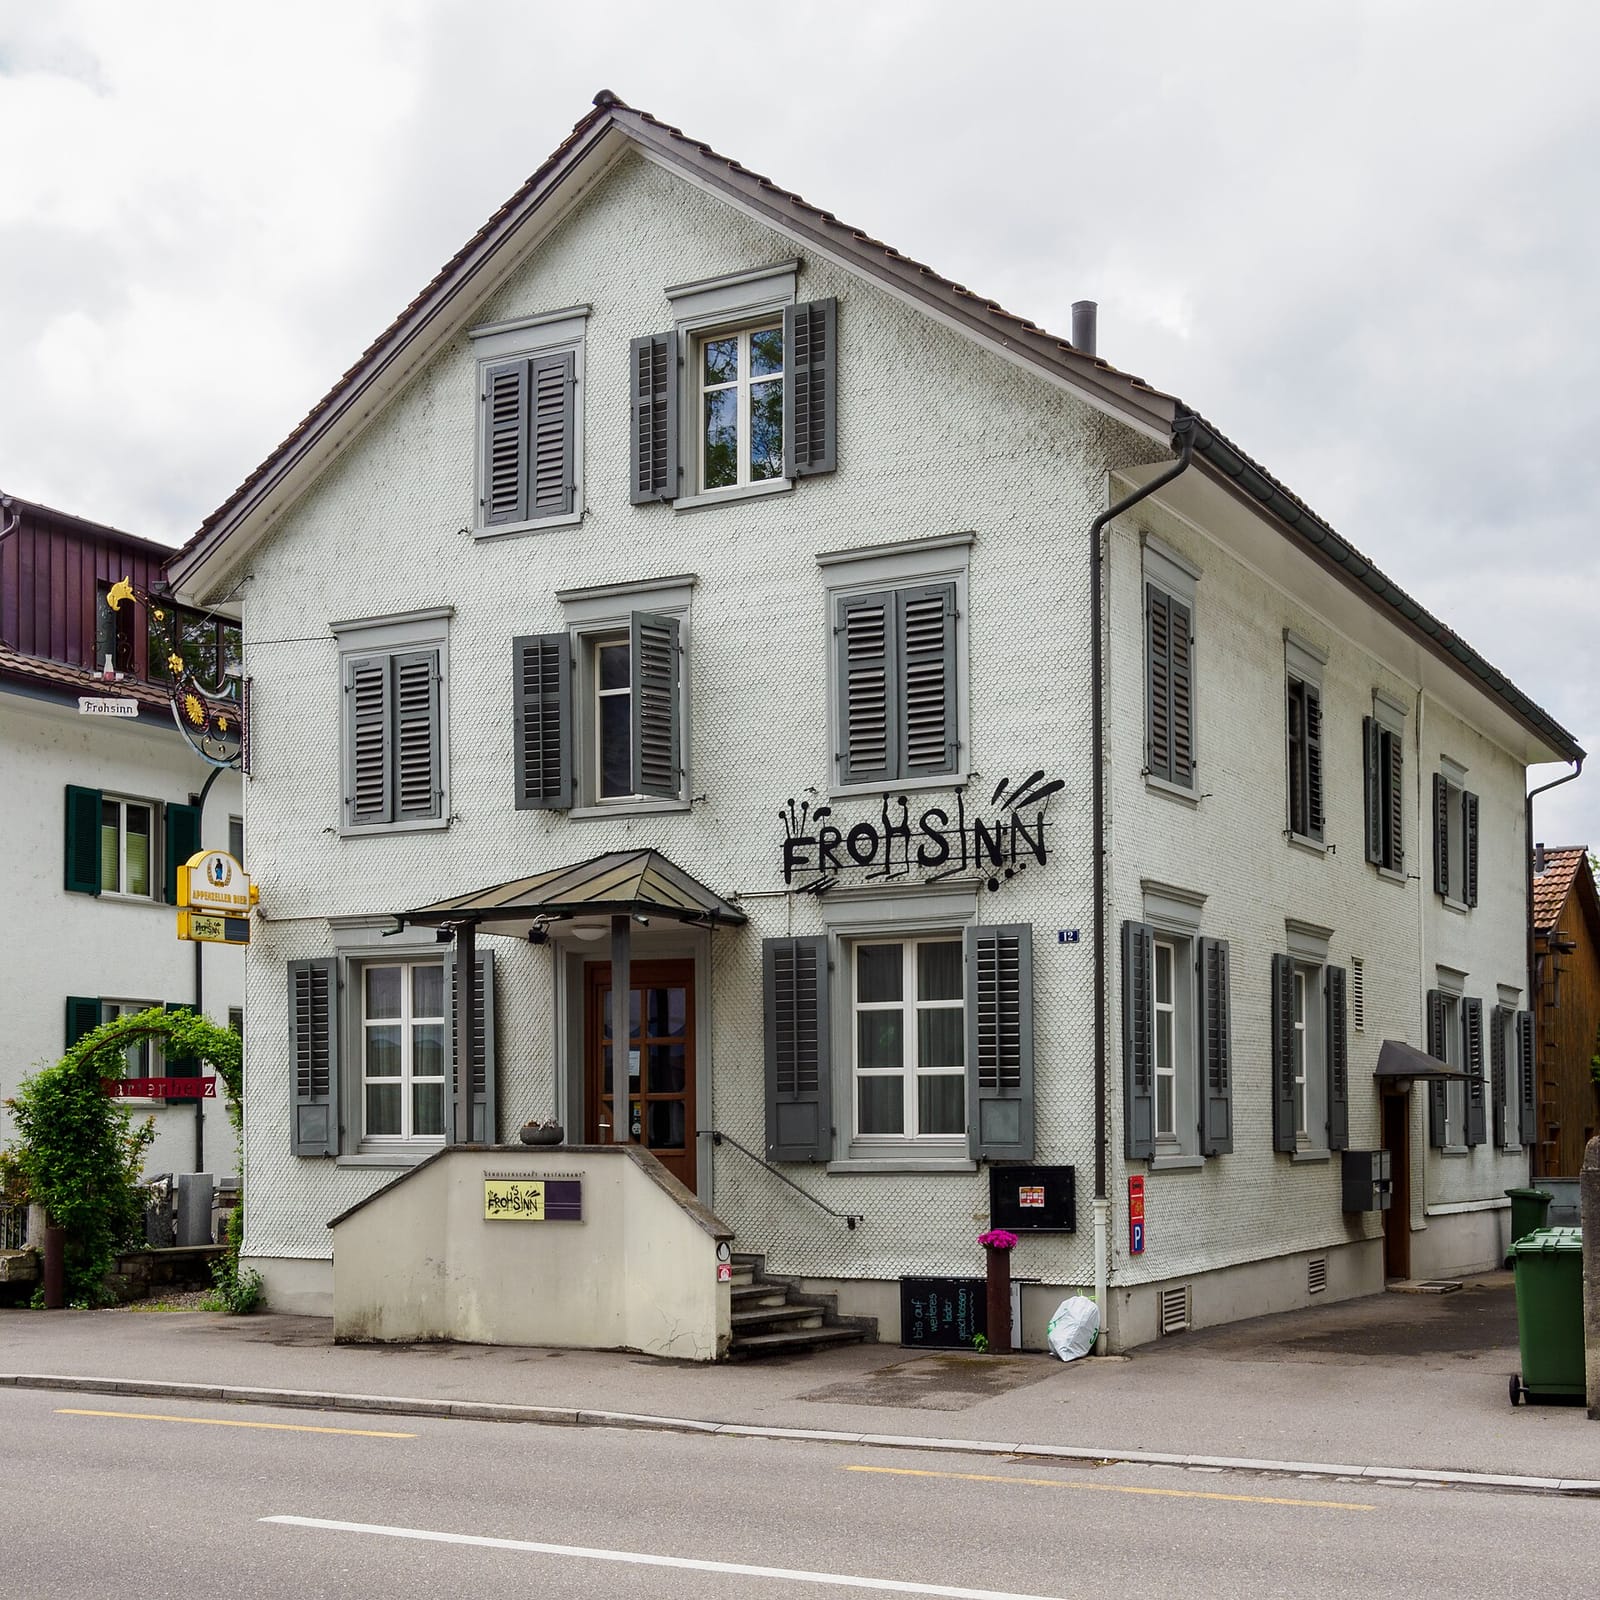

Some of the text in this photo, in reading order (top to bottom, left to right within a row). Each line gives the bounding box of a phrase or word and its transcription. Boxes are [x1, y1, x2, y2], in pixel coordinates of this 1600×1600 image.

[85, 701, 133, 714] Frohsinn
[783, 787, 1047, 884] FROHSINN
[192, 889, 247, 905] APPENZELLER BIER
[1062, 931, 1075, 942] 12
[487, 1191, 538, 1213] FROHSINN
[1134, 1226, 1142, 1249] P
[911, 1298, 927, 1339] bis auf
[924, 1293, 938, 1332] weiteres
[957, 1288, 971, 1341] geschlossen
